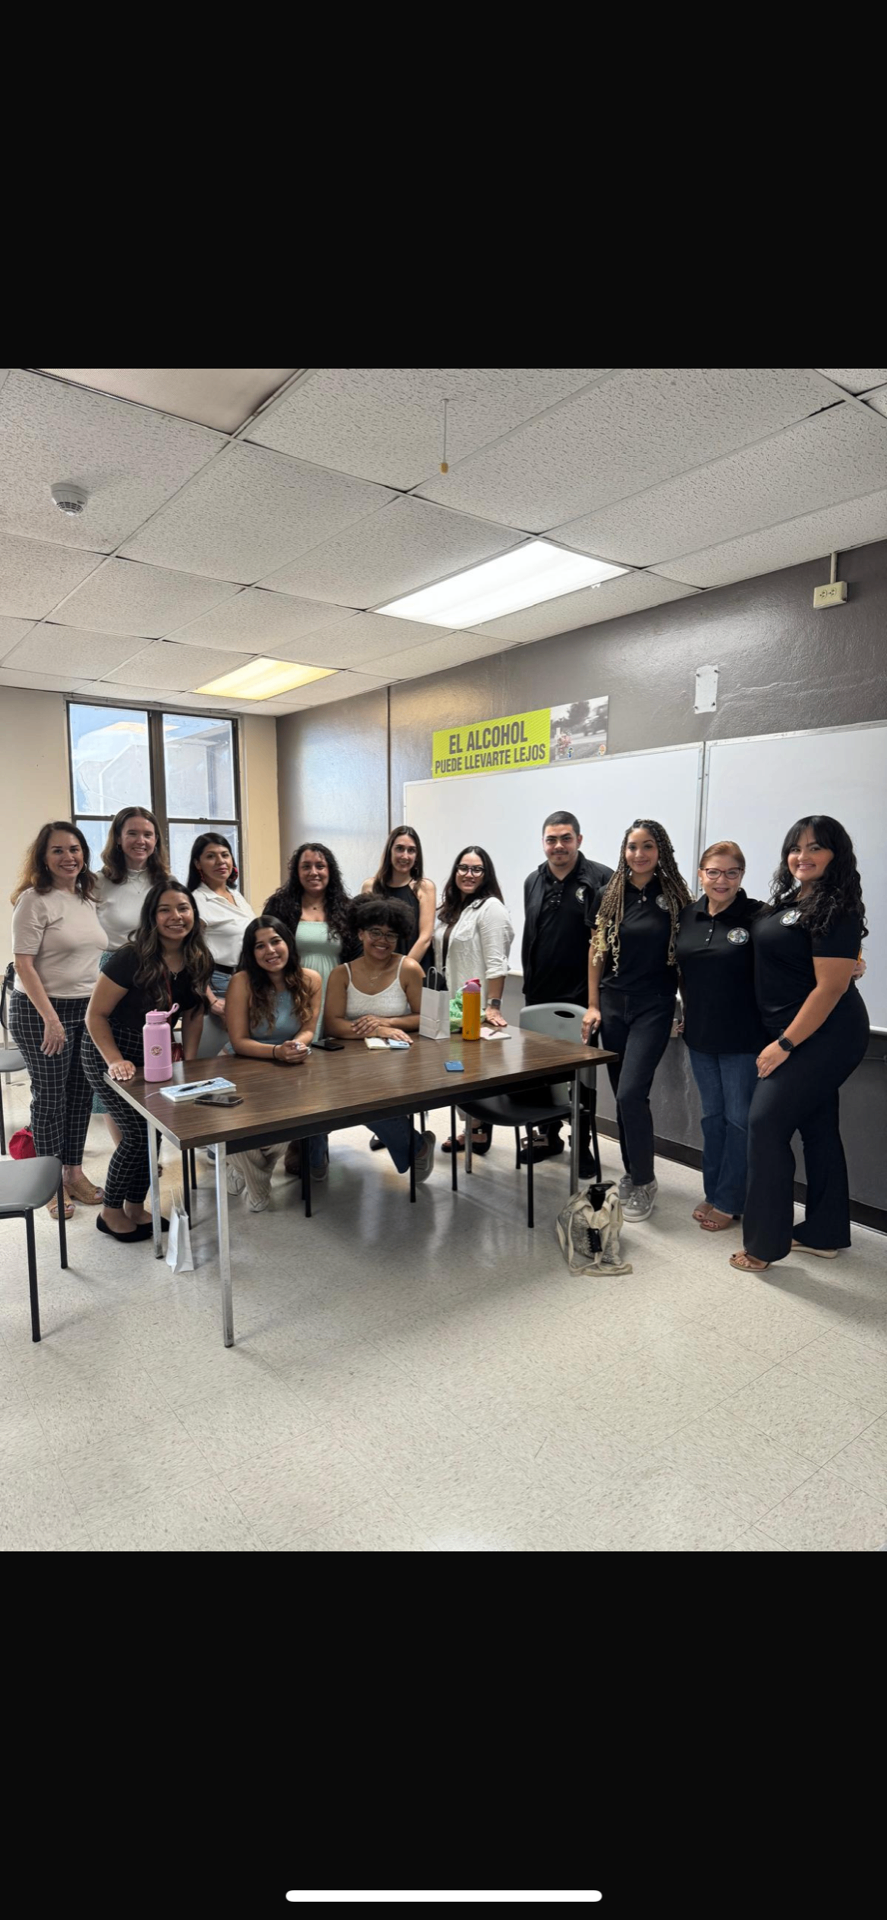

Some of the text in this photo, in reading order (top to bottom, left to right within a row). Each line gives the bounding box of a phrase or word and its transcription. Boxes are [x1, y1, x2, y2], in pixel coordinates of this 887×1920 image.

[449, 721, 528, 754] EL ALCOHOL
[435, 744, 546, 774] PUEDE LLEVARTE LEJOS
